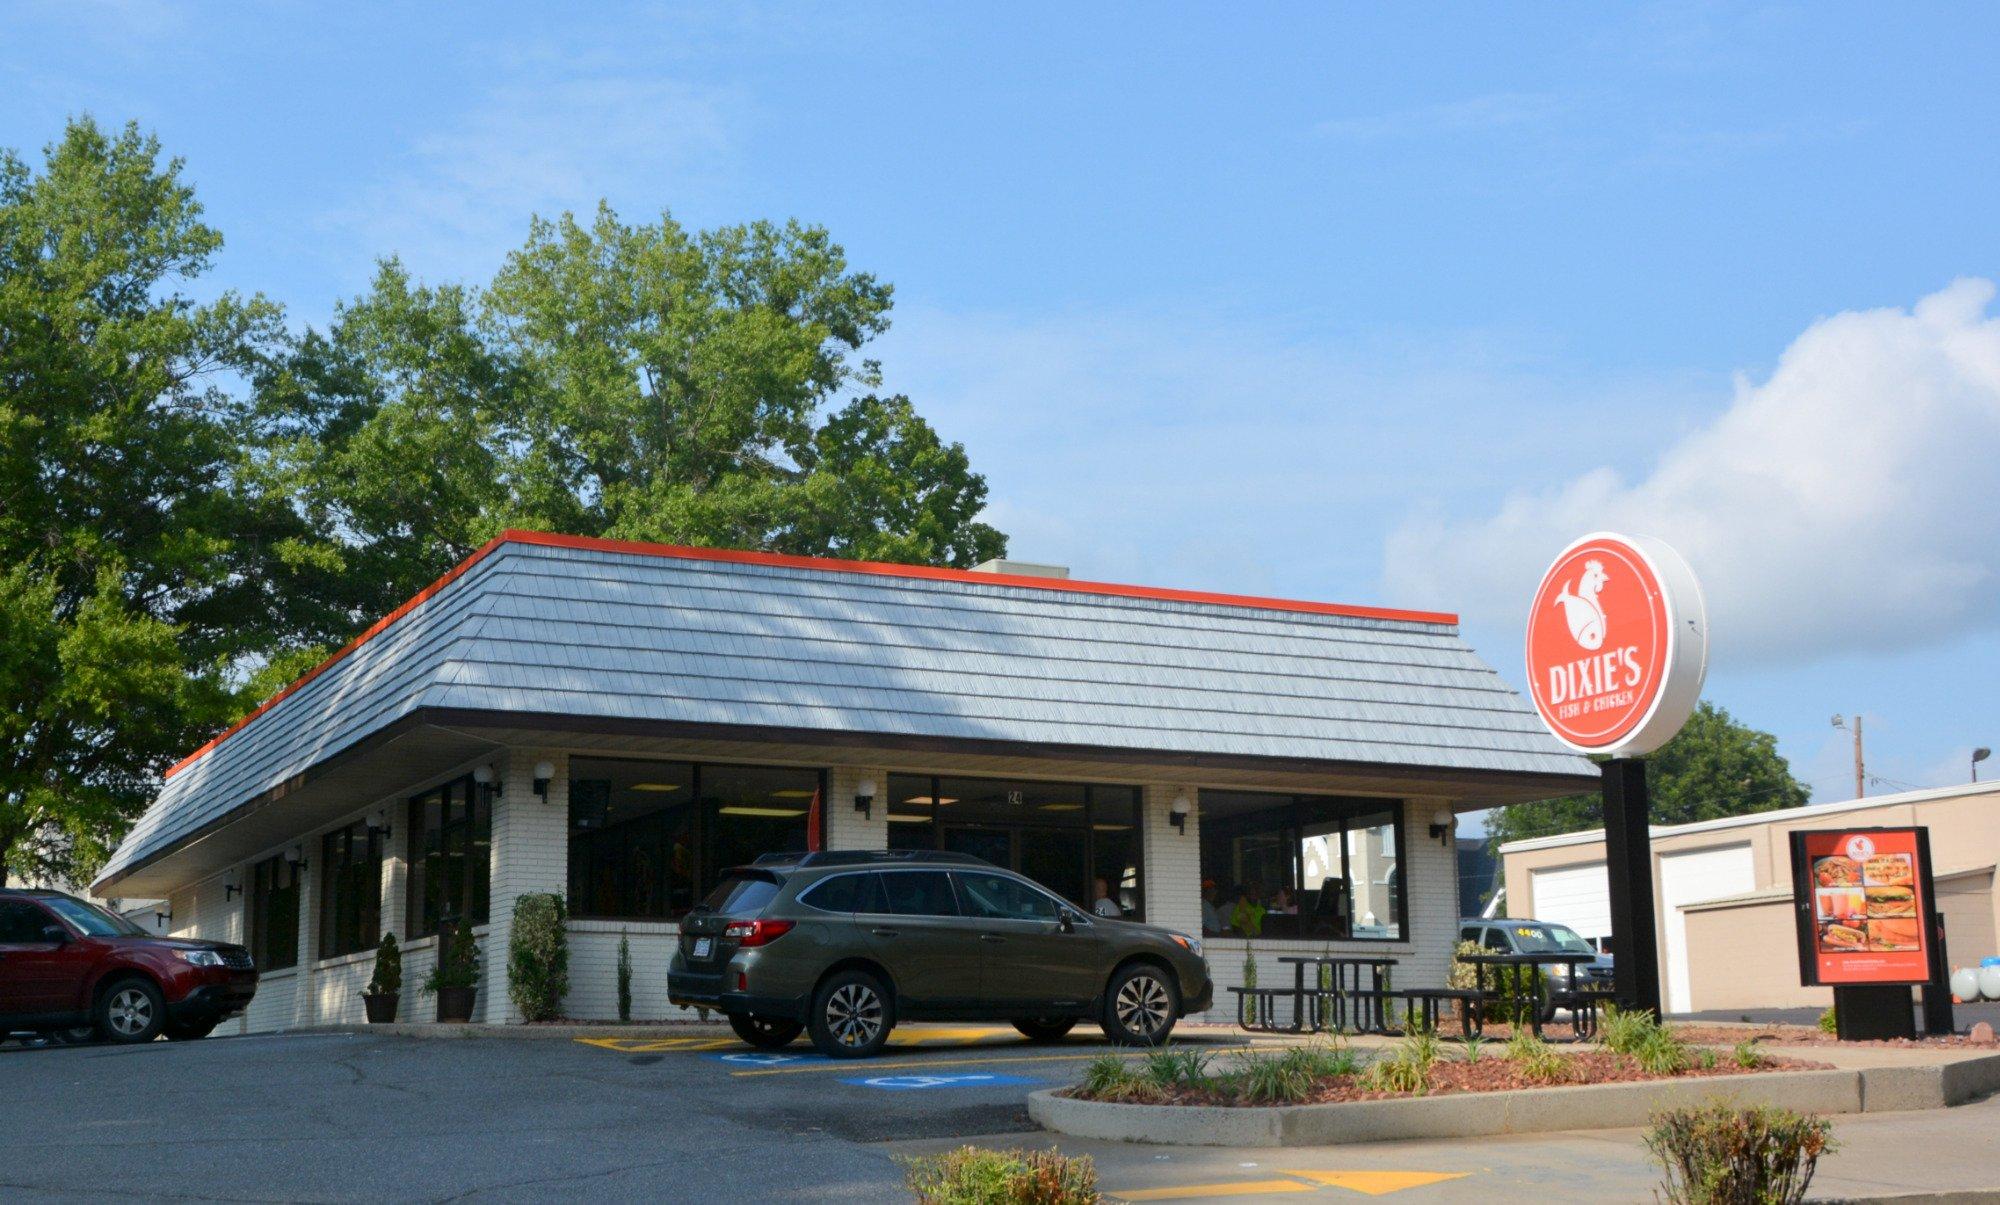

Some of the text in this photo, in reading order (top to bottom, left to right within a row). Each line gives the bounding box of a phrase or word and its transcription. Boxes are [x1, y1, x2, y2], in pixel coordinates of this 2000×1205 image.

[1549, 646, 1642, 705] DIXIE'S
[1559, 691, 1633, 719] FISH & CHICKEN
